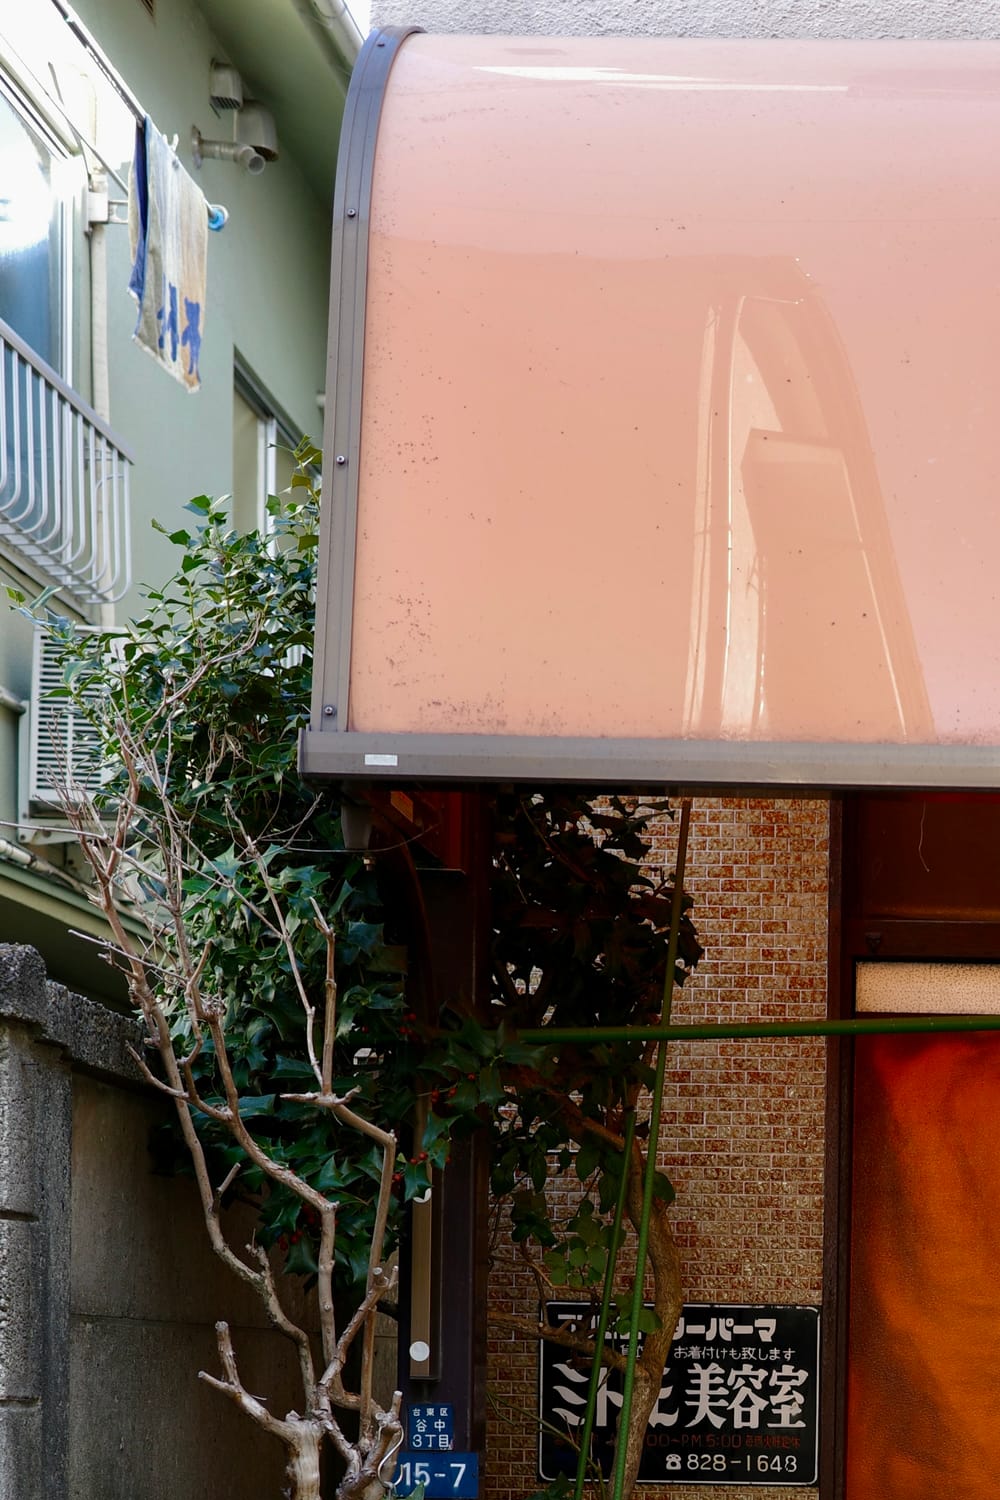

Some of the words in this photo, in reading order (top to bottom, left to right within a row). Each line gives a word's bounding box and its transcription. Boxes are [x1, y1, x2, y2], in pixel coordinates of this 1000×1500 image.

[674, 1345, 796, 1361] お着付けも致します
[412, 1408, 448, 1417] 台東区
[416, 1419, 446, 1432] 谷中
[412, 1434, 449, 1448] 3丁目
[403, 1462, 466, 1488] 15-7
